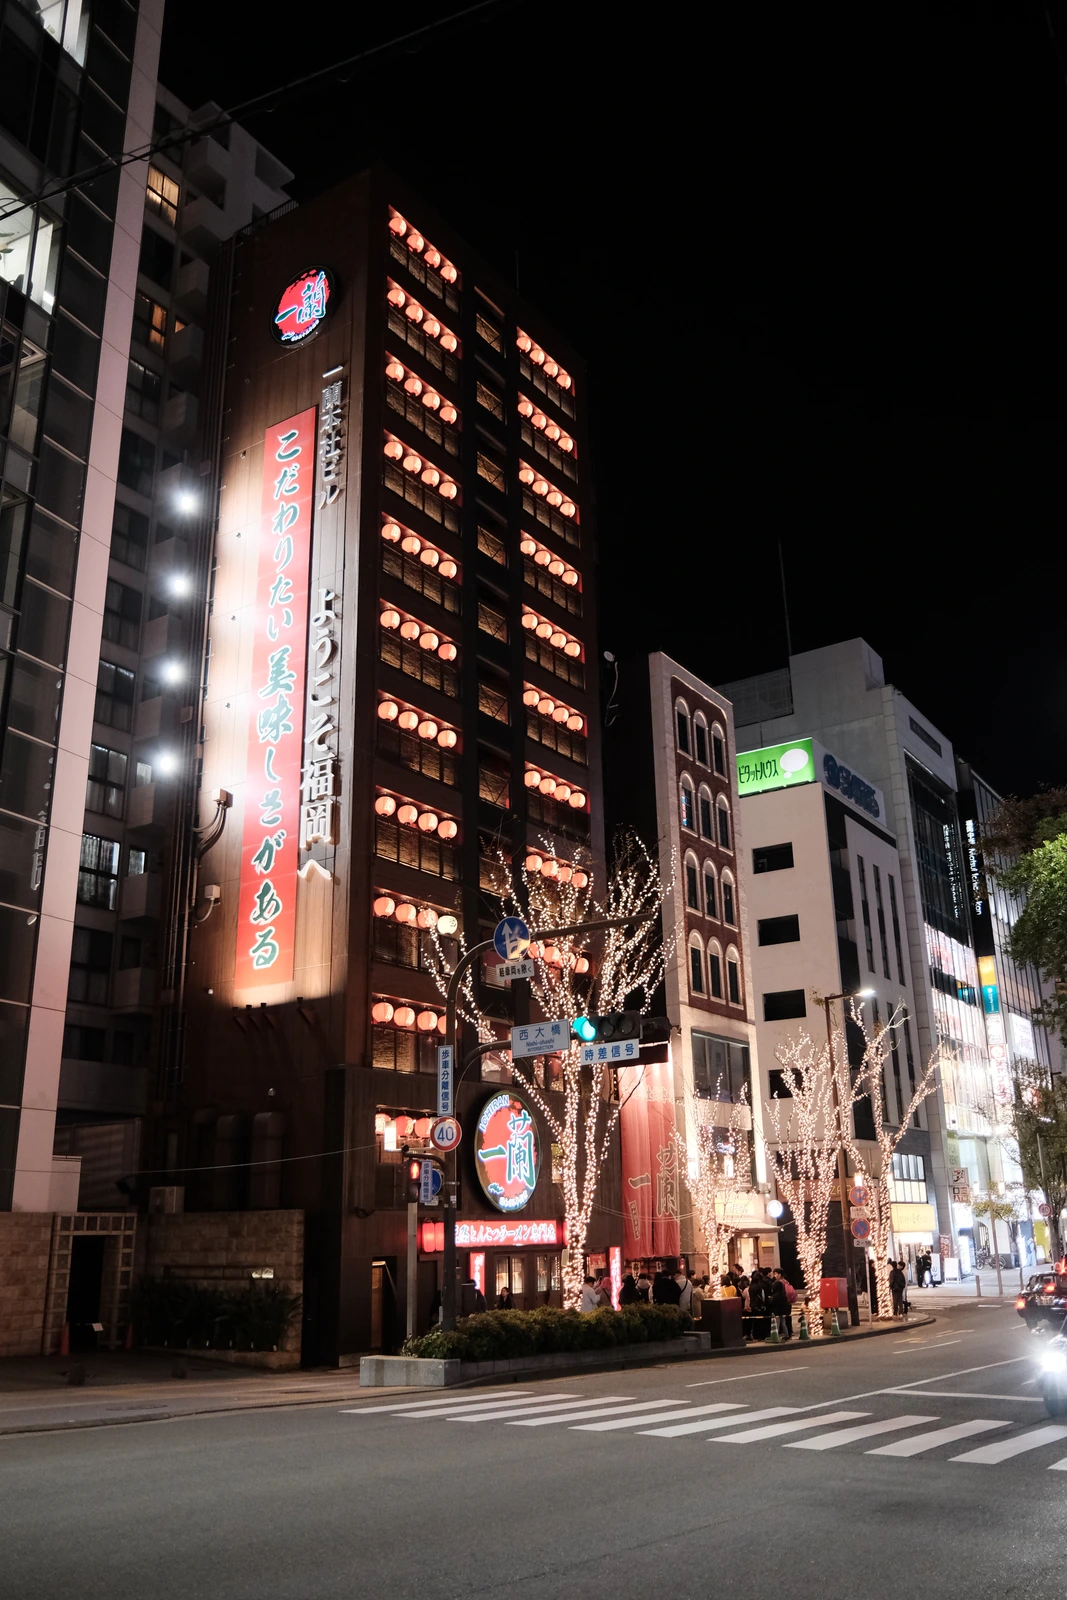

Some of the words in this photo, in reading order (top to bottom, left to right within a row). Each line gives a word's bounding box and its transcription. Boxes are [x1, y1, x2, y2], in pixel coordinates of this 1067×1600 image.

[318, 365, 343, 510] 一蘭本社ビル
[297, 588, 338, 880] ようこそ福岡へ
[738, 760, 779, 784] ピタットハウス
[519, 1024, 561, 1041] 西大橋
[584, 1043, 634, 1061] 時差信号
[441, 1050, 450, 1112] 歩車分離信号
[479, 1095, 509, 1132] ICHIRAN
[437, 1126, 454, 1141] 40
[478, 1109, 536, 1190] 一蘭
